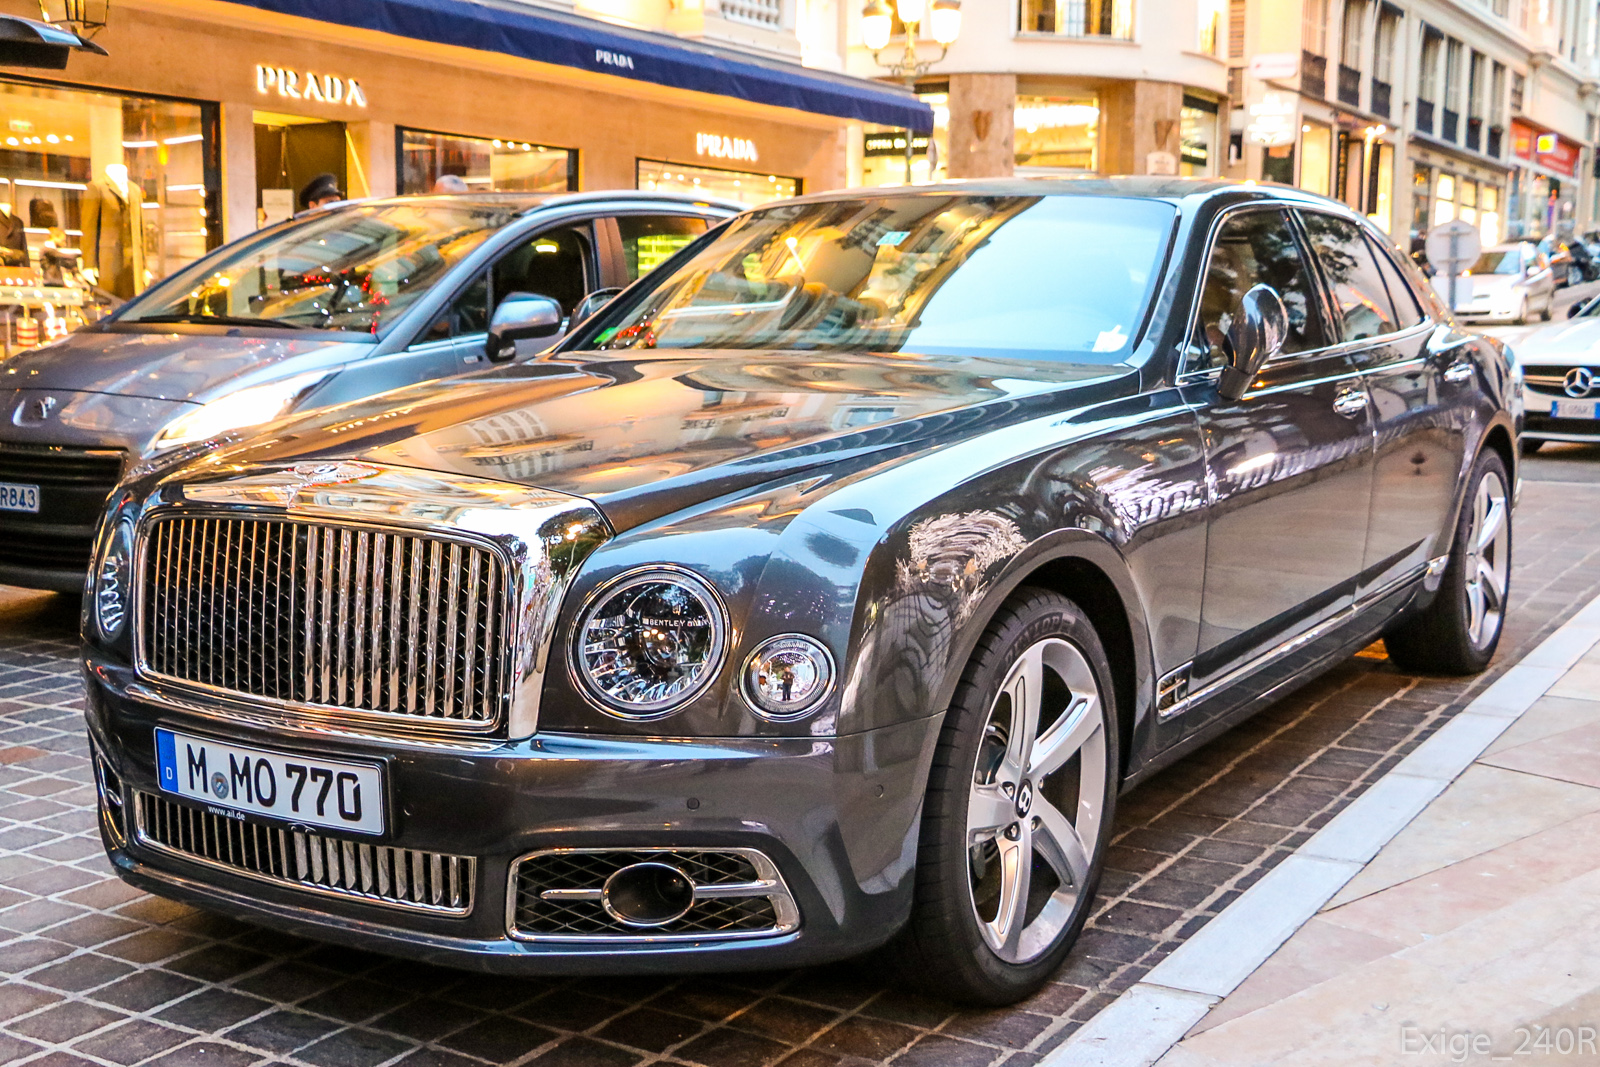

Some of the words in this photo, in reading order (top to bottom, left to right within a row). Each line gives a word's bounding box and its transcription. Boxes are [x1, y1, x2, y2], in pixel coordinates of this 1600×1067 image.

[596, 49, 634, 70] PRADA
[256, 64, 367, 108] PRADA
[696, 132, 758, 162] PRADA
[0, 487, 36, 508] R843
[649, 618, 685, 627] BENTLEY
[166, 766, 173, 780] D
[285, 763, 362, 822] 770
[207, 805, 246, 821] www.ail.de
